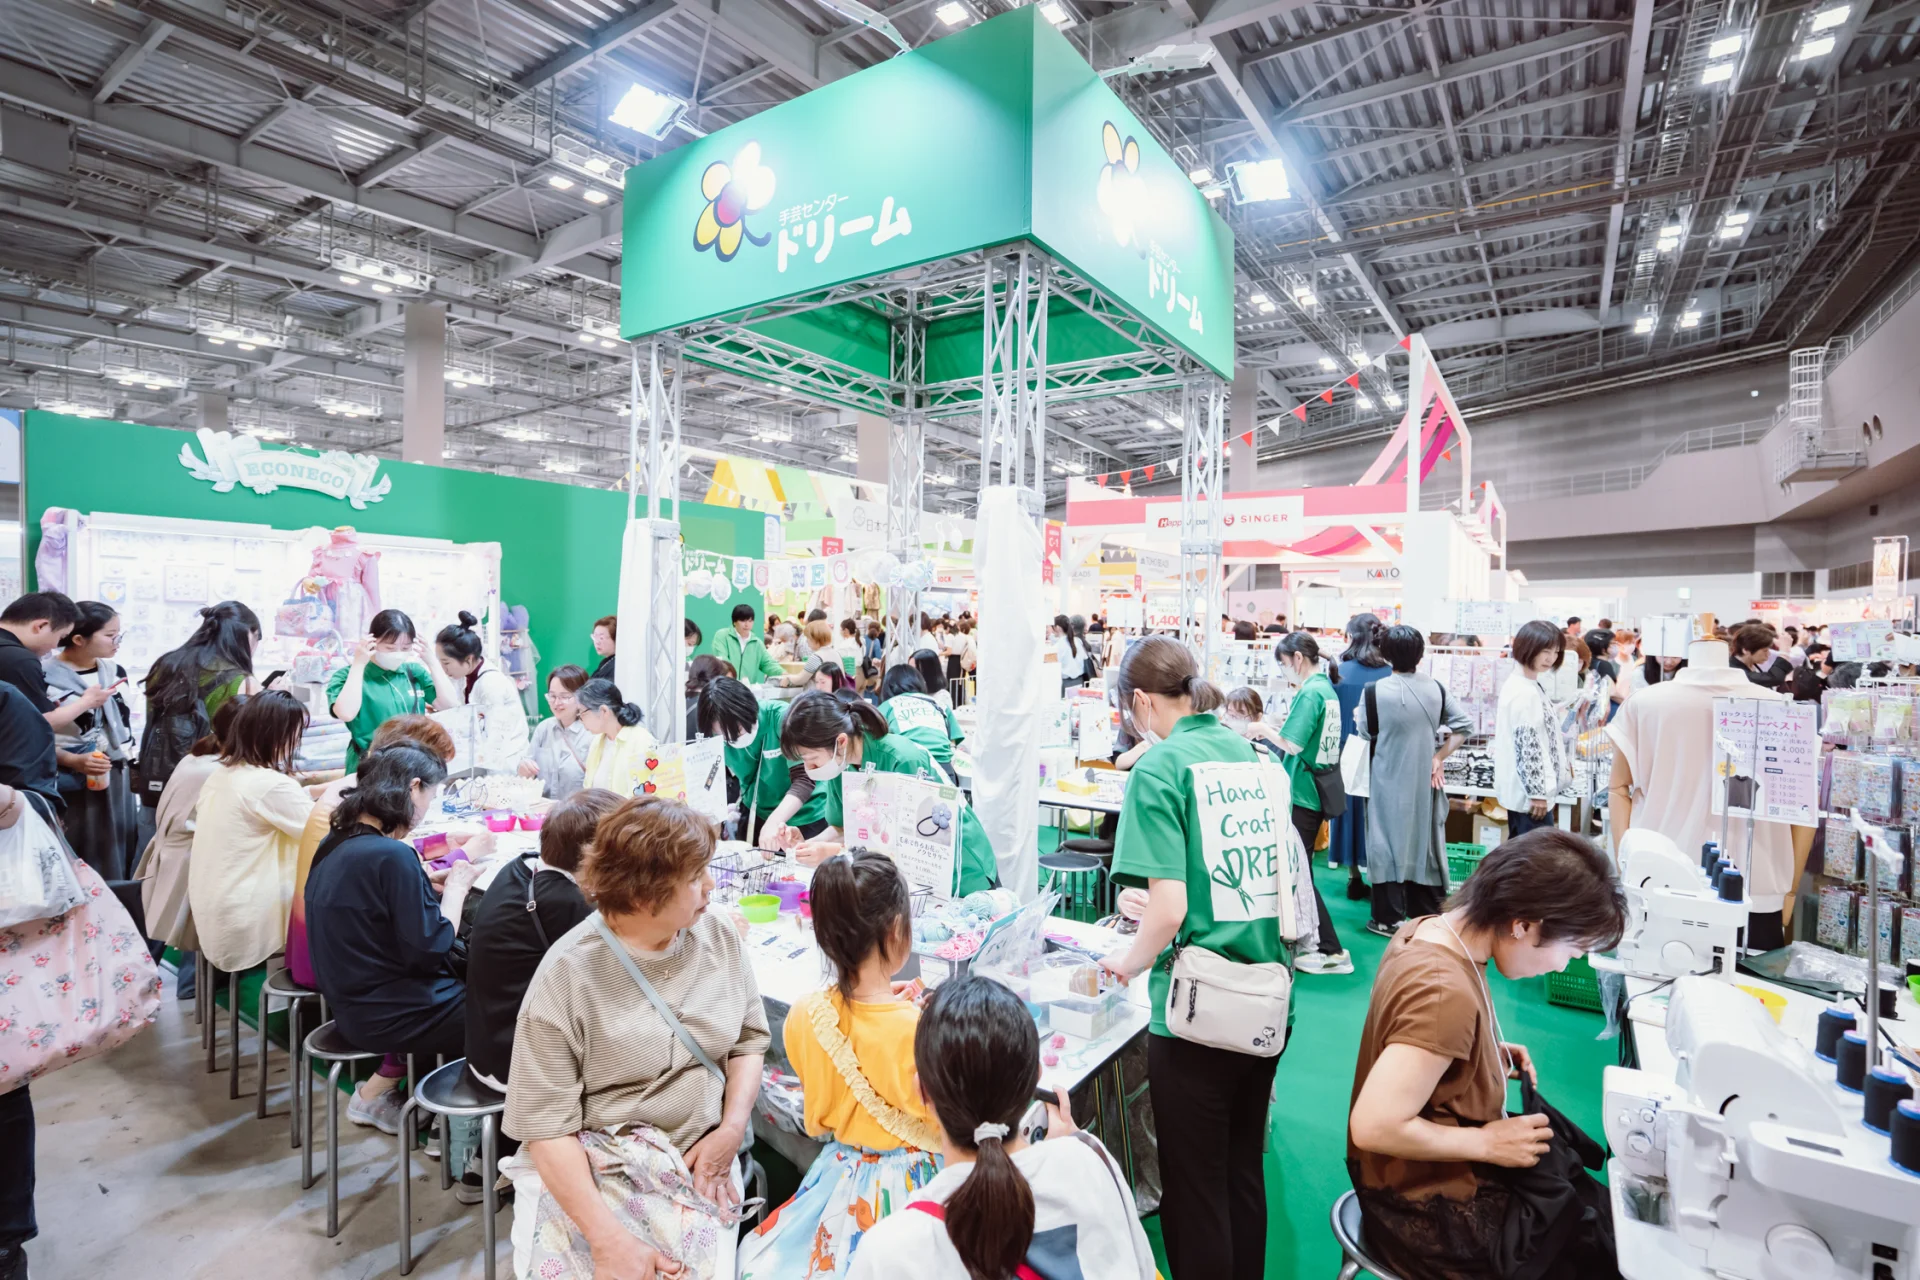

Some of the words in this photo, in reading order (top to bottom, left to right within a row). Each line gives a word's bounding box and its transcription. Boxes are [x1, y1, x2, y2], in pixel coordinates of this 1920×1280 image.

[778, 193, 849, 227] 手芸センター
[777, 195, 912, 273] ドリーム
[1148, 256, 1204, 336] ドリーム
[244, 462, 345, 489] ECONECO
[1157, 517, 1182, 528] Happ
[1240, 513, 1288, 523] SINGER
[1719, 717, 1803, 732] オーバーベスト
[1780, 745, 1806, 755] 4,000
[1205, 777, 1267, 806] Hand
[1220, 808, 1276, 839] Craf
